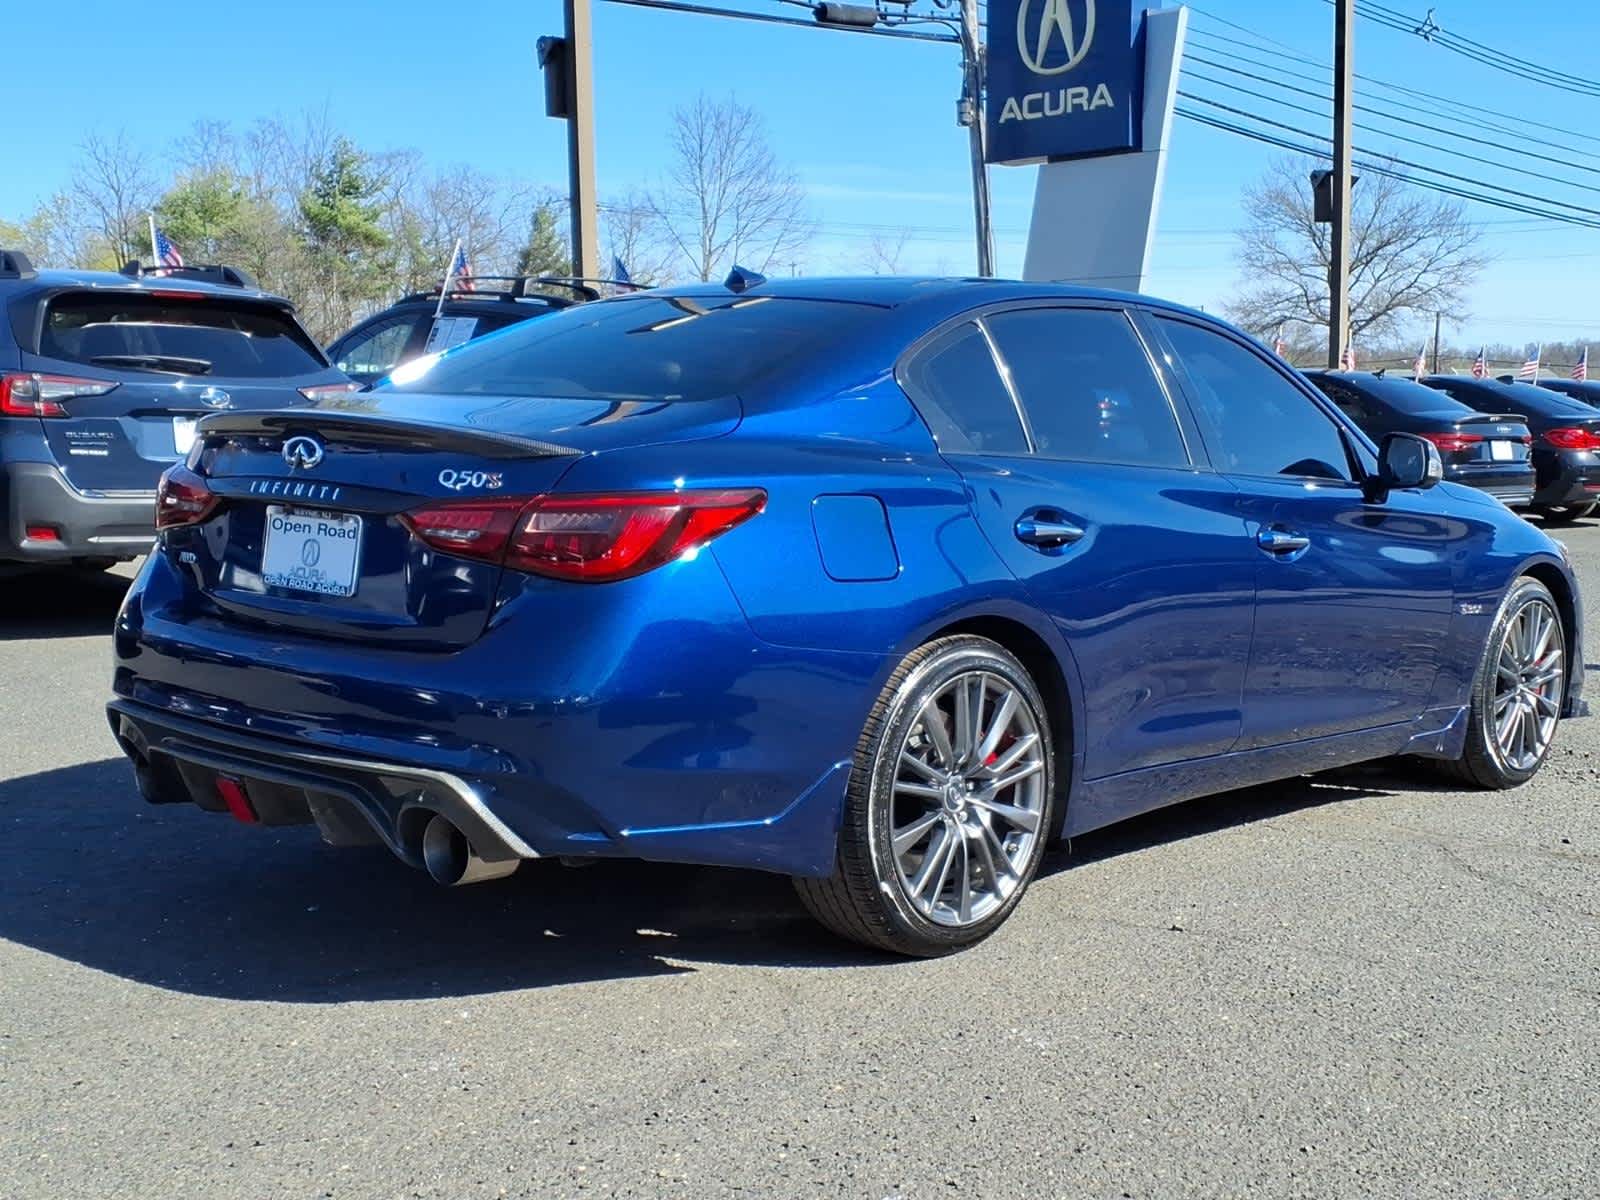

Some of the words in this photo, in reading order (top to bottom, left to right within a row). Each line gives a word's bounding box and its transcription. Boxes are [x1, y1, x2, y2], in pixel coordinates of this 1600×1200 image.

[998, 83, 1115, 124] ACURA
[249, 480, 340, 501] INFINITI
[271, 517, 312, 535] Open
[317, 522, 357, 540] Road
[288, 567, 328, 582] ACURA
[288, 579, 314, 591] ROAD
[315, 583, 346, 595] ACURA
